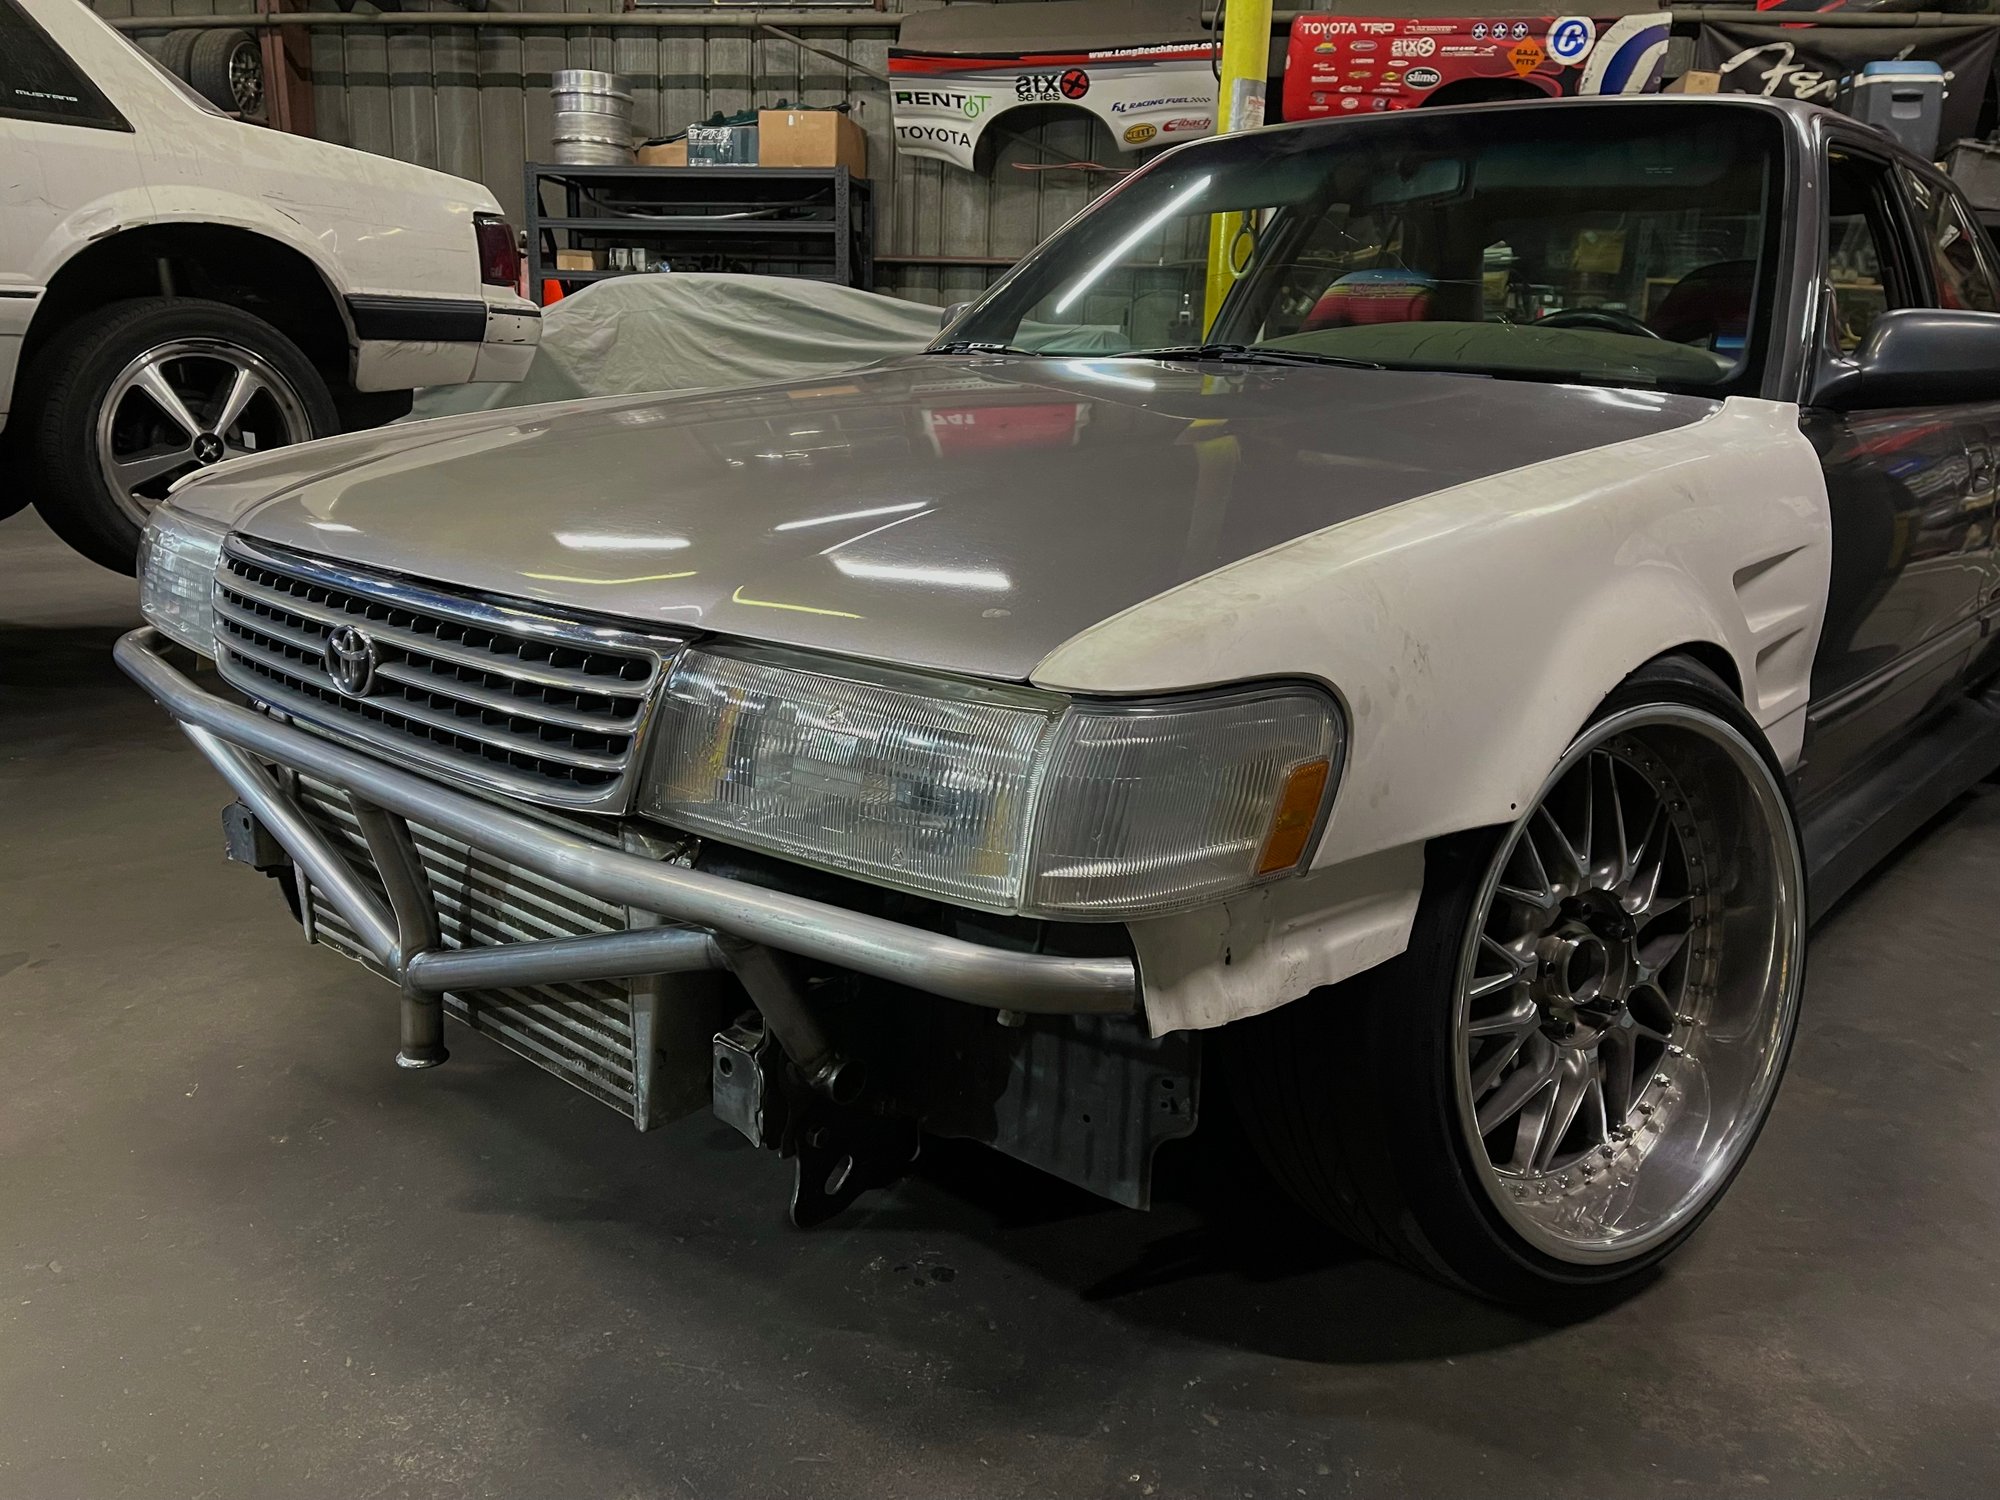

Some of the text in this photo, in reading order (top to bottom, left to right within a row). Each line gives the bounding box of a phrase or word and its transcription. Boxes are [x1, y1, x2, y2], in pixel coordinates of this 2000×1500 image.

[1303, 22, 1357, 34] TOYOTA
[1360, 22, 1395, 34] TRD
[1391, 40, 1418, 52] atx
[1516, 48, 1539, 56] BAJA
[1516, 58, 1536, 66] PITS
[1407, 71, 1438, 83] slime
[1015, 74, 1060, 94] atx
[1017, 92, 1061, 102] series
[1129, 99, 1164, 109] RACING
[897, 126, 972, 148] TOYOTA
